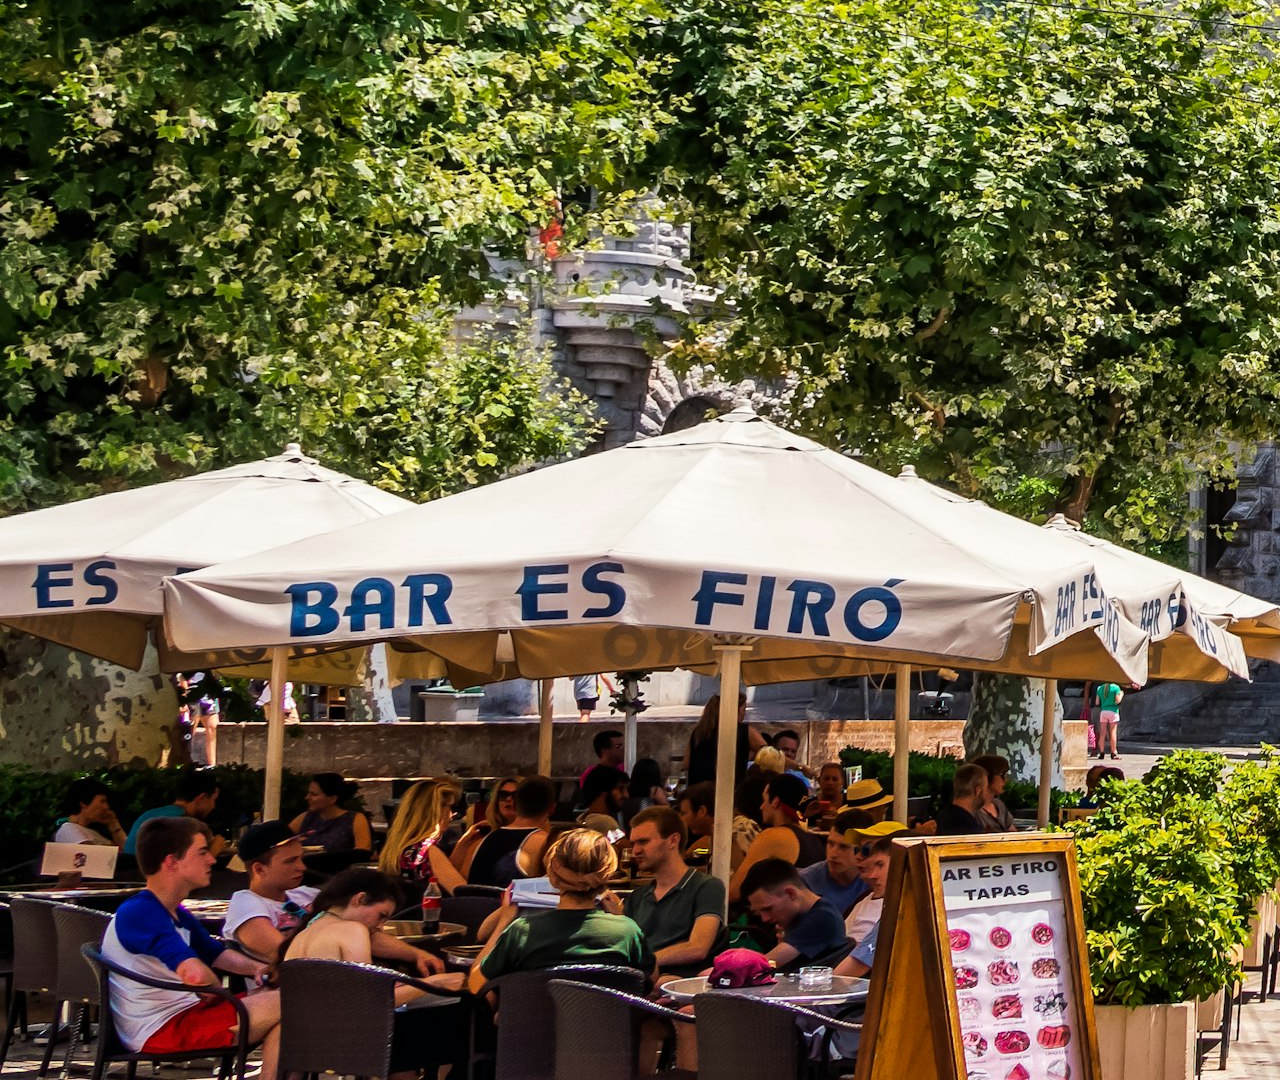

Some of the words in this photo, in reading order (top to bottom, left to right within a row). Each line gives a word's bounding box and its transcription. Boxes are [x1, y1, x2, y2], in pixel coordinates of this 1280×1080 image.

[31, 560, 119, 609] ES
[284, 572, 453, 637] BAR
[515, 561, 627, 621] ES
[690, 570, 906, 642] FIRÓ
[1054, 580, 1076, 637] BAR
[1140, 598, 1162, 636] BAR
[978, 865, 1004, 879] ES
[1011, 860, 1058, 876] FIRO
[964, 884, 1030, 901] TAPAS
